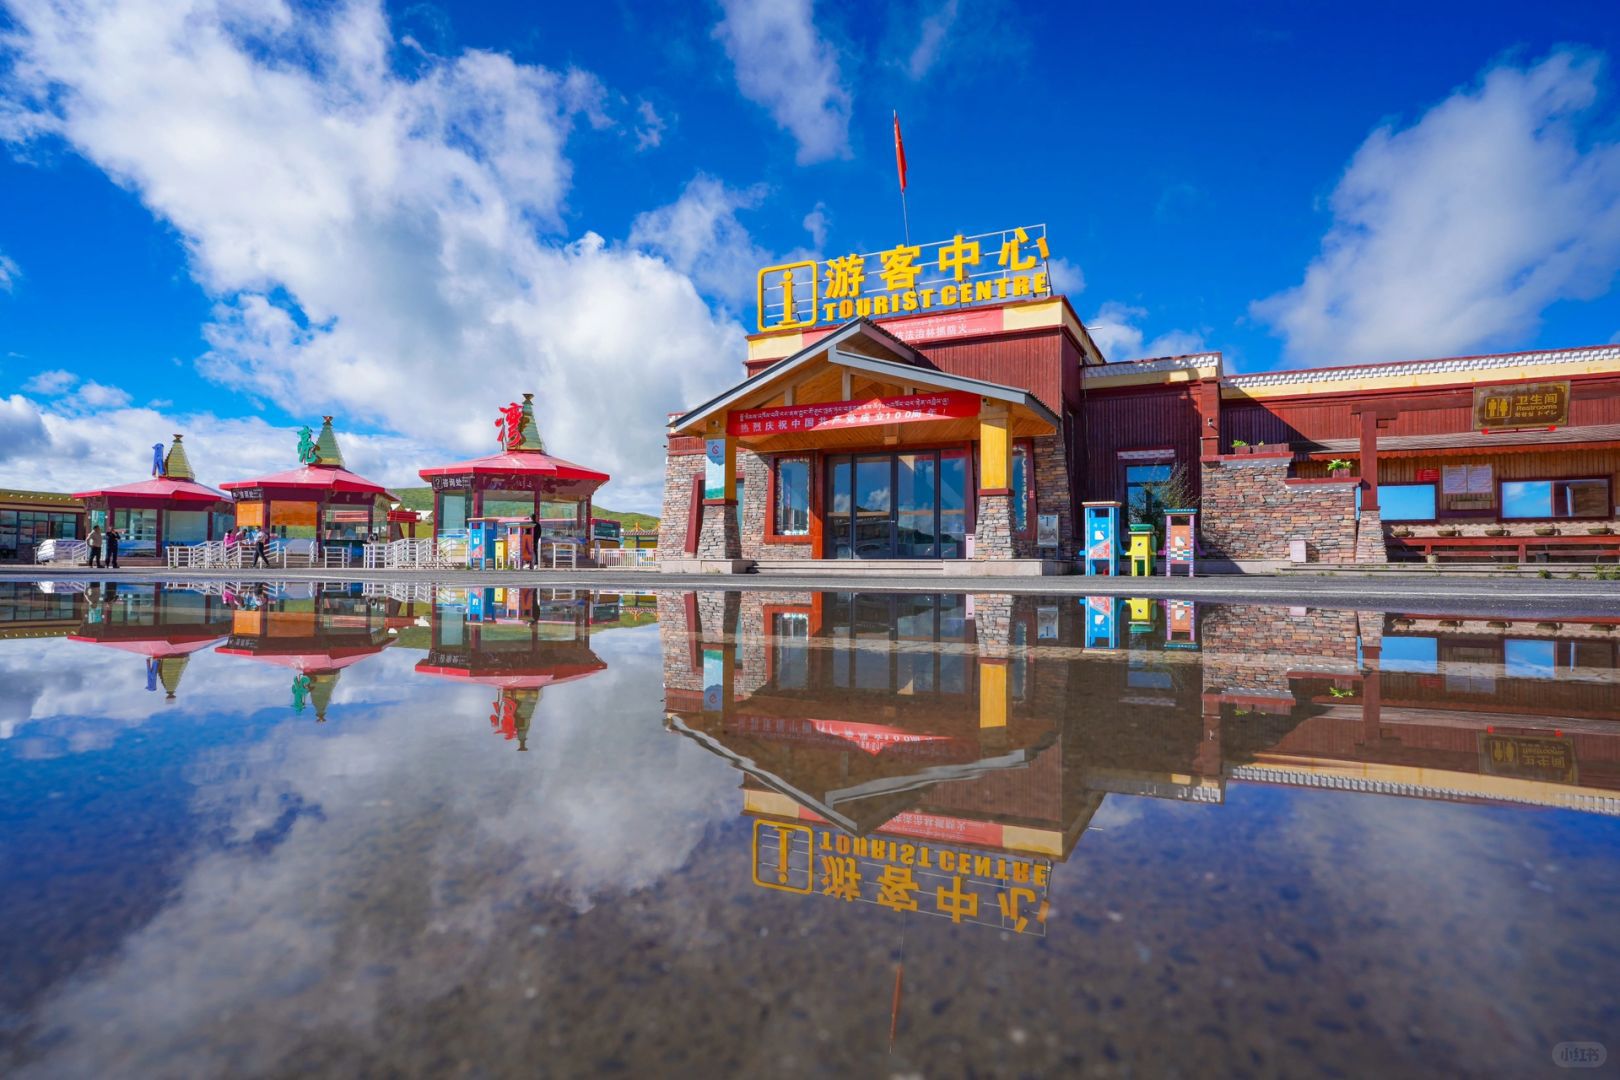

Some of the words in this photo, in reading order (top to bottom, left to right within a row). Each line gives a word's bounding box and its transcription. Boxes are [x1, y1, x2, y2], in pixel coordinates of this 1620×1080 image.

[825, 227, 1049, 298] 游客中心
[823, 285, 935, 321] TOURIST
[940, 272, 1048, 306] CENTRE
[1515, 393, 1557, 405] 卫生间
